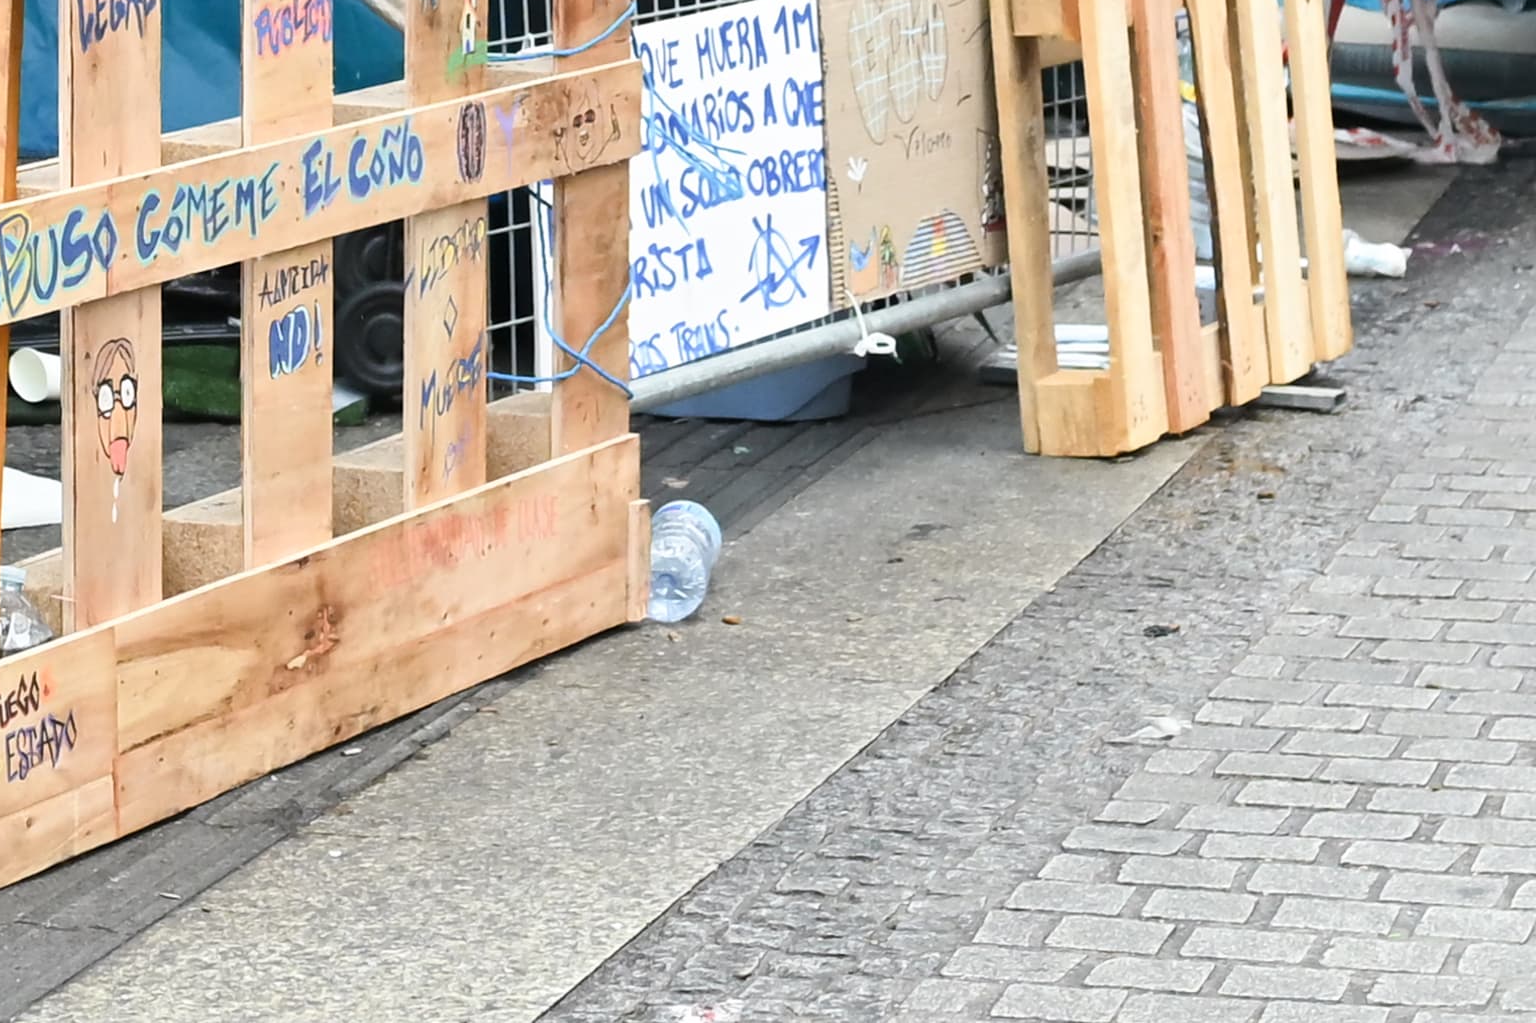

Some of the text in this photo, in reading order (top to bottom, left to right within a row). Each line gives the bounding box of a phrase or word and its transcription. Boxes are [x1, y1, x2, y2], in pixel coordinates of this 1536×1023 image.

[695, 15, 768, 80] MUERA
[763, 82, 777, 127] A
[302, 139, 341, 217] EL
[348, 116, 424, 200] COÑO
[5, 709, 77, 782] ESTADO
